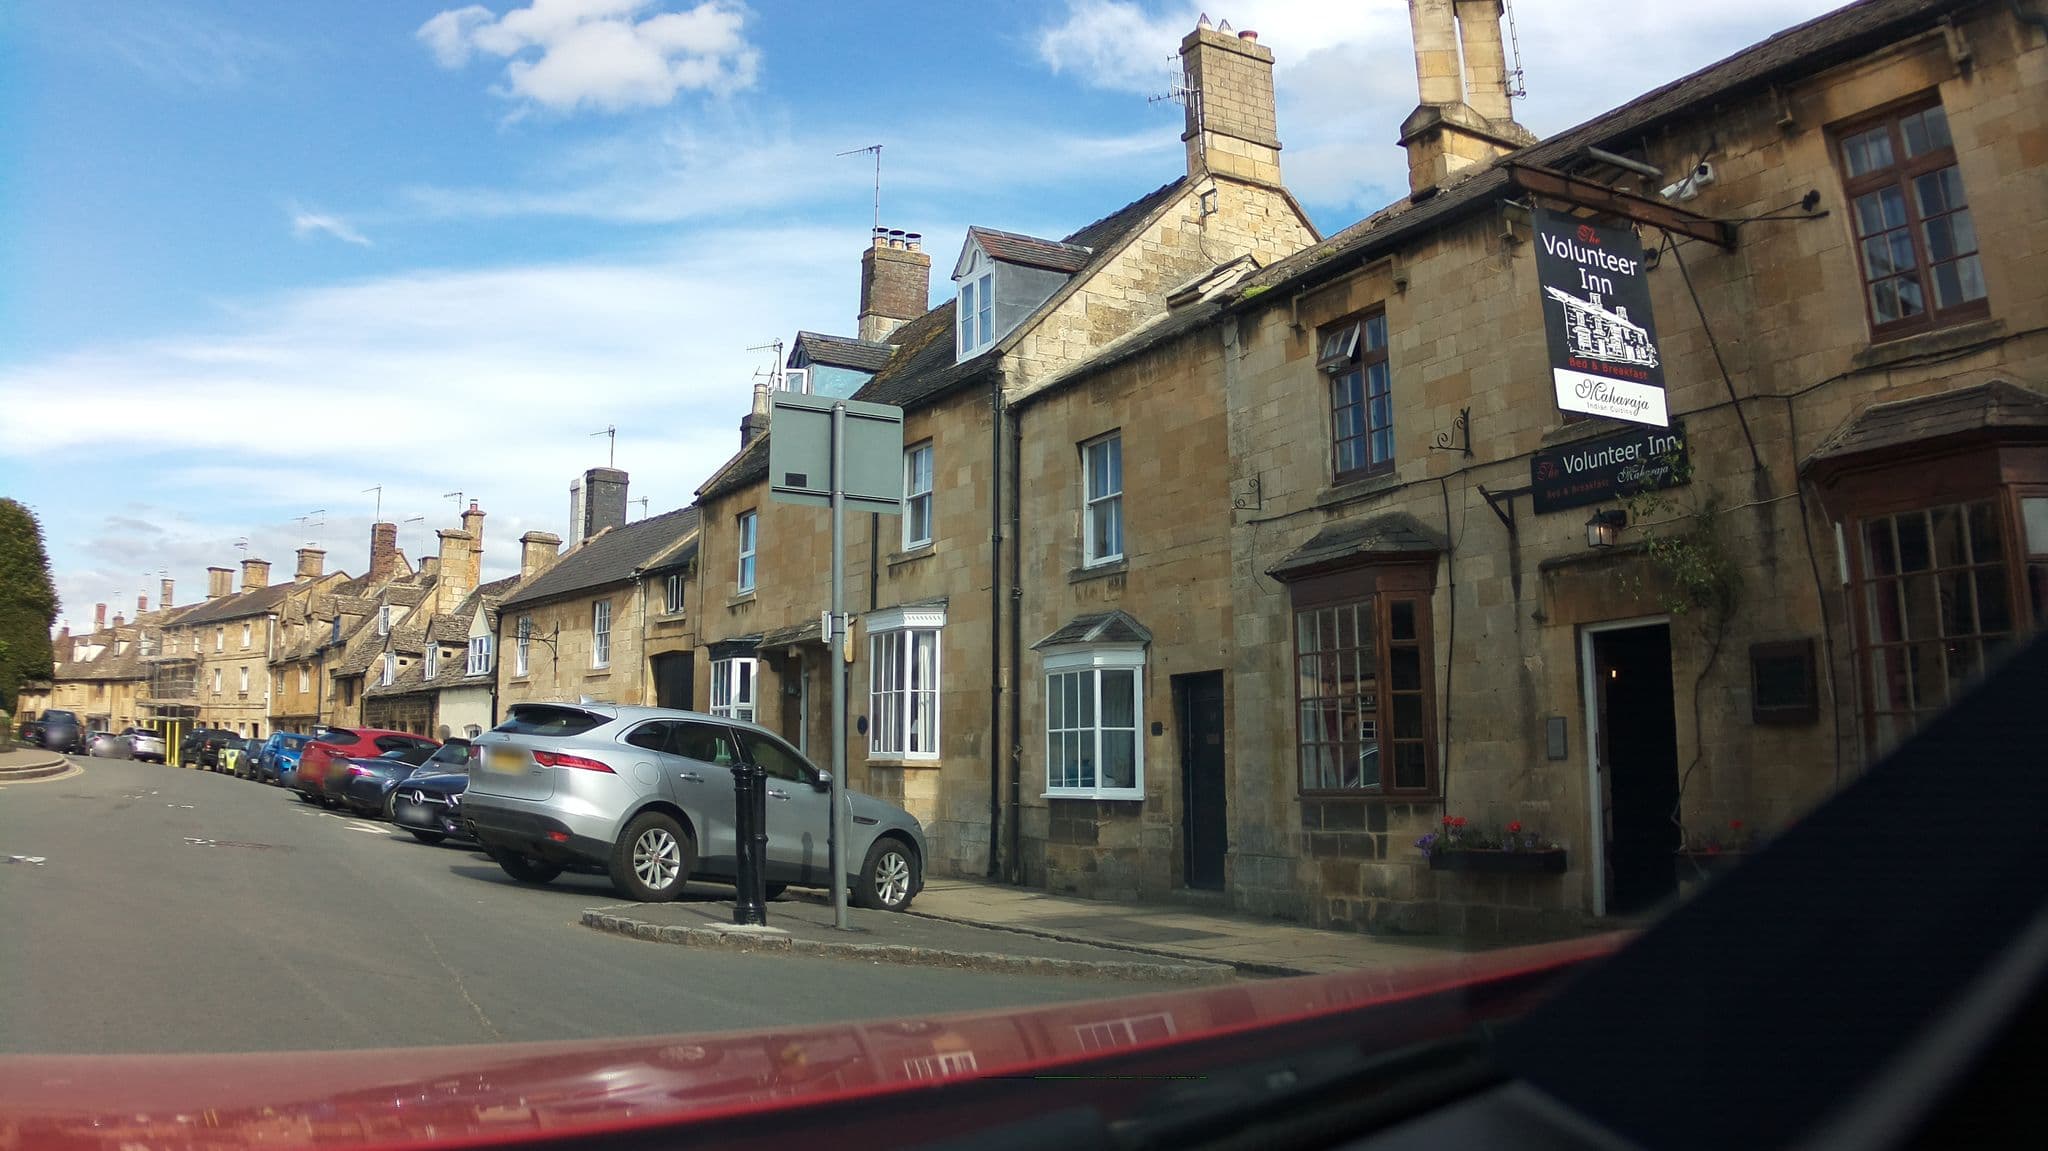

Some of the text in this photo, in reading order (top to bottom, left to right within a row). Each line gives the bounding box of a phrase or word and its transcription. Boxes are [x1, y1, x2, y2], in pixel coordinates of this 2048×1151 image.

[1577, 224, 1600, 245] The
[1541, 232, 1637, 276] Volunteer
[1578, 267, 1613, 295] Inn
[1569, 356, 1587, 369] Bed
[1602, 363, 1649, 379] Breakfast
[1575, 379, 1649, 416] Maharaja
[1562, 443, 1642, 474] Volunteer
[1648, 435, 1677, 456] Inn
